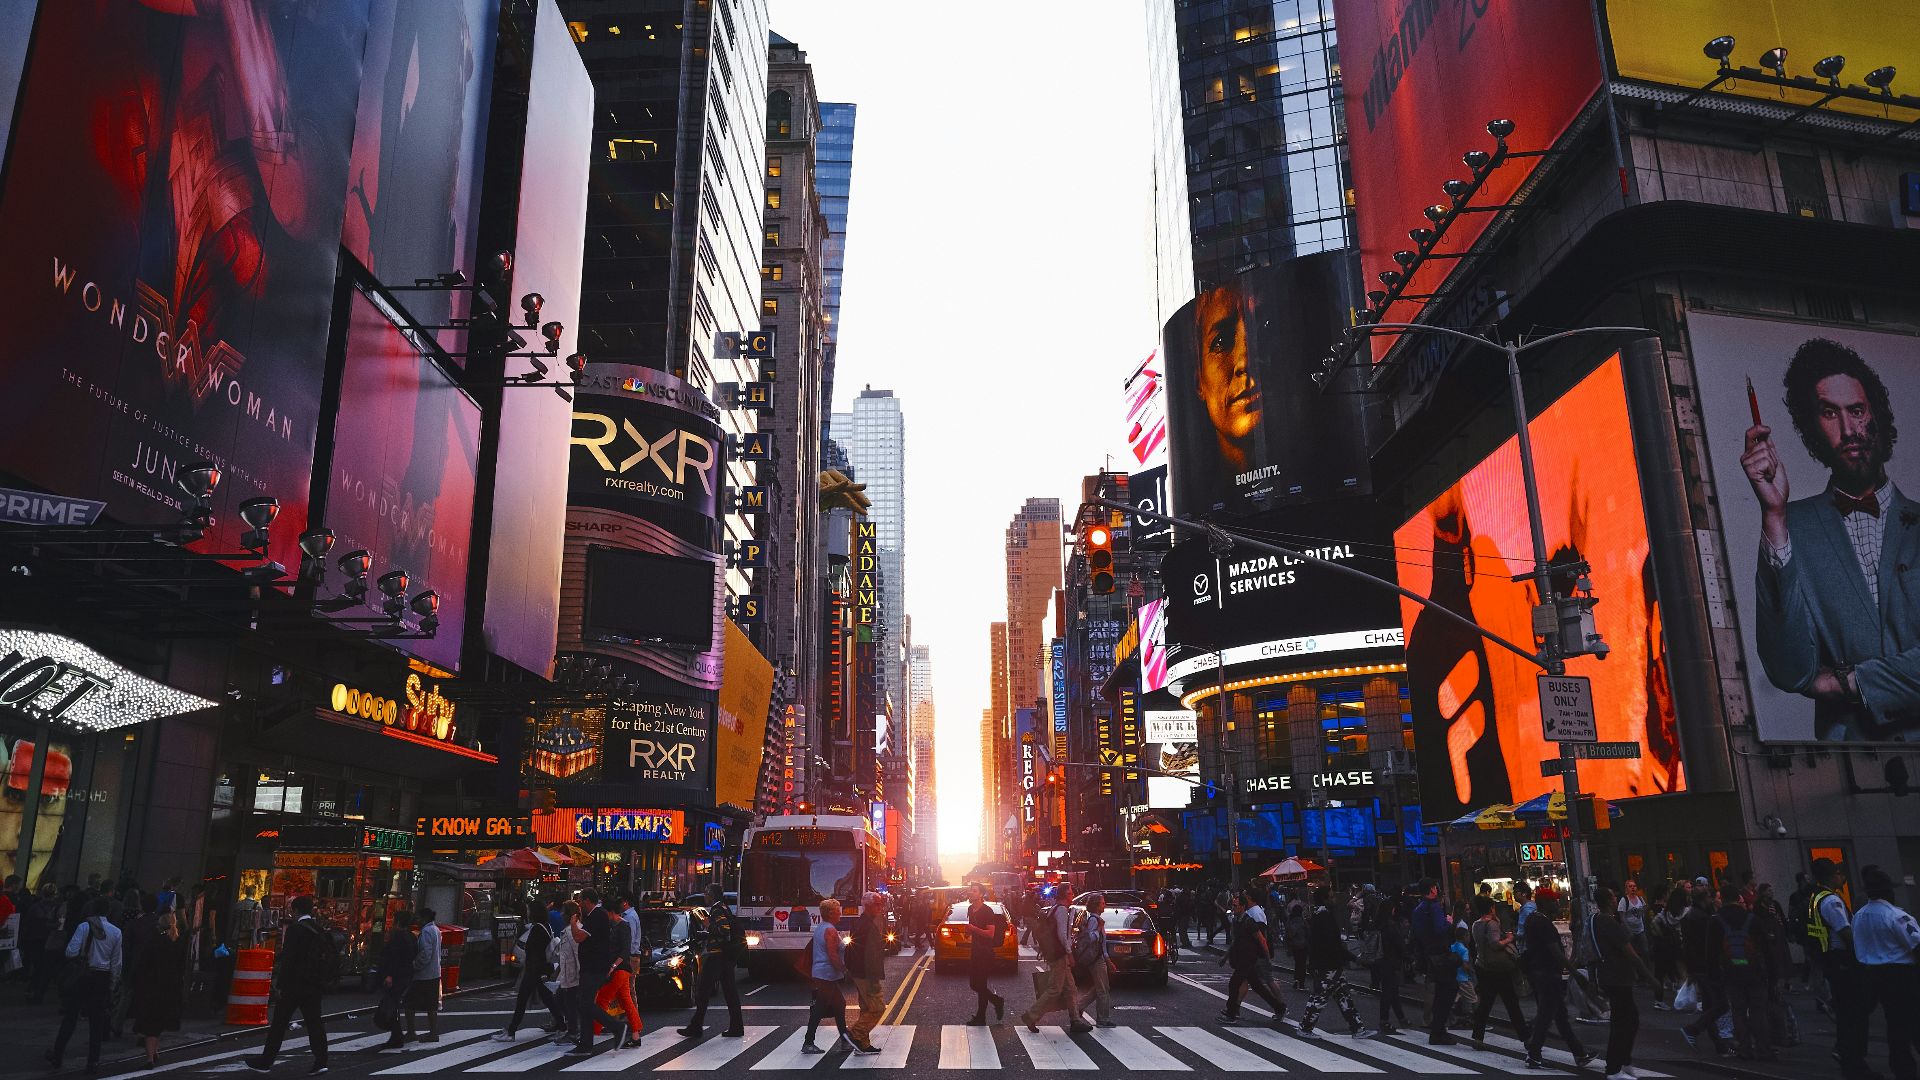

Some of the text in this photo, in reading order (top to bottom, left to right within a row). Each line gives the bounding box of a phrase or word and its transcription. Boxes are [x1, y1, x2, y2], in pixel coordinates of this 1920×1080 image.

[53, 256, 292, 441] WONDER WOMAN
[62, 367, 83, 388] THE
[90, 384, 128, 414] FUTURE
[134, 409, 148, 423] OF
[152, 420, 190, 448] JUSTICE
[230, 464, 249, 481] WITH
[131, 441, 184, 485] JUN
[569, 411, 713, 497] RXR
[605, 476, 684, 501] rxrrealty.com
[342, 469, 464, 565] WONDER WOMAN
[565, 522, 622, 533] SHARP
[858, 523, 875, 624] MADAME
[1229, 556, 1279, 578] MAZDA
[1229, 571, 1296, 595] SERVICES
[1261, 641, 1303, 657] CHASE
[1053, 660, 1065, 680] 42
[1193, 655, 1218, 670] CHASE
[1548, 681, 1581, 694] BUSES
[664, 703, 686, 717] New
[688, 706, 705, 720] York
[1054, 692, 1067, 732] STUDIOS
[1554, 695, 1578, 707] ONLY
[611, 717, 707, 742] for the 21st Century
[1122, 690, 1136, 746] VICTORY
[1584, 729, 1594, 737] FRI
[629, 739, 696, 772] RXR
[1055, 735, 1067, 759] DUKE
[1590, 744, 1637, 758] Broadway
[643, 769, 686, 781] REALTY
[1022, 744, 1034, 822] REGAL
[1246, 776, 1291, 792] CHASE
[1314, 771, 1374, 788] CHASE
[431, 817, 480, 836] KNOW
[576, 814, 673, 838] CHAMPS
[1522, 844, 1554, 861] SODA
